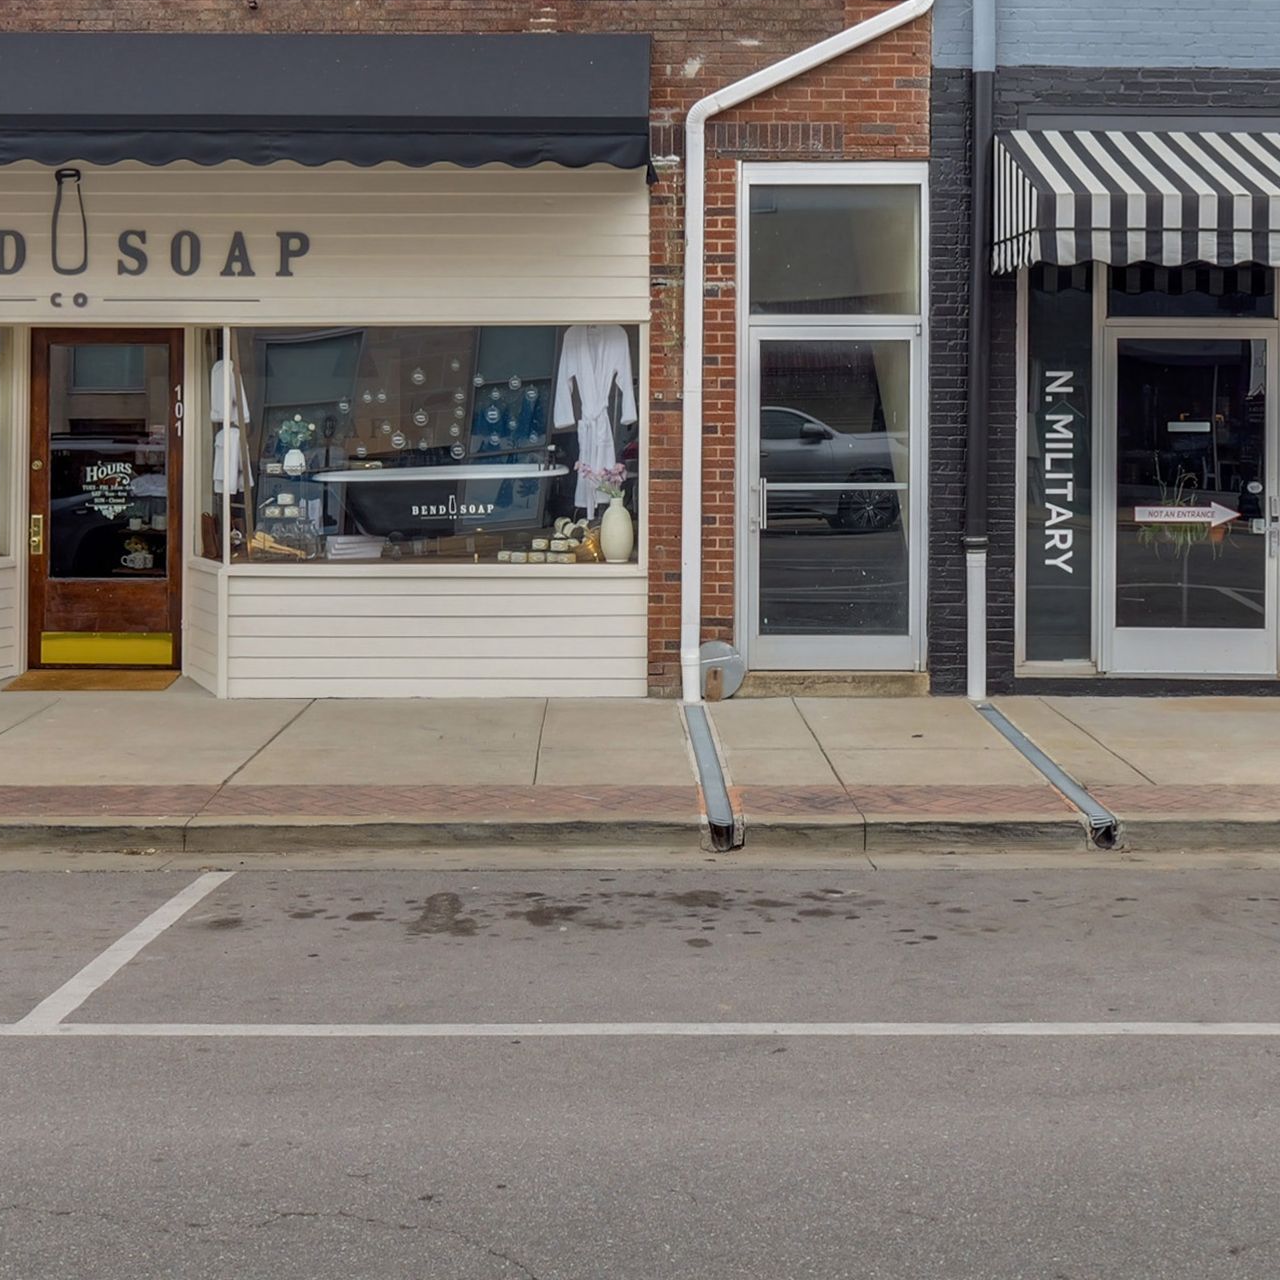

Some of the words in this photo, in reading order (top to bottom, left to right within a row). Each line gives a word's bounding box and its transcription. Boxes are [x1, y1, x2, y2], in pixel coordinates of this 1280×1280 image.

[117, 230, 311, 277] SOAP
[50, 292, 89, 308] CO
[1045, 370, 1074, 402] N.
[174, 384, 183, 437] 101
[411, 505, 447, 516] BEND
[460, 504, 495, 514] SOAP
[1044, 414, 1074, 574] MILITARY
[1176, 510, 1216, 518] ENTRANCE
